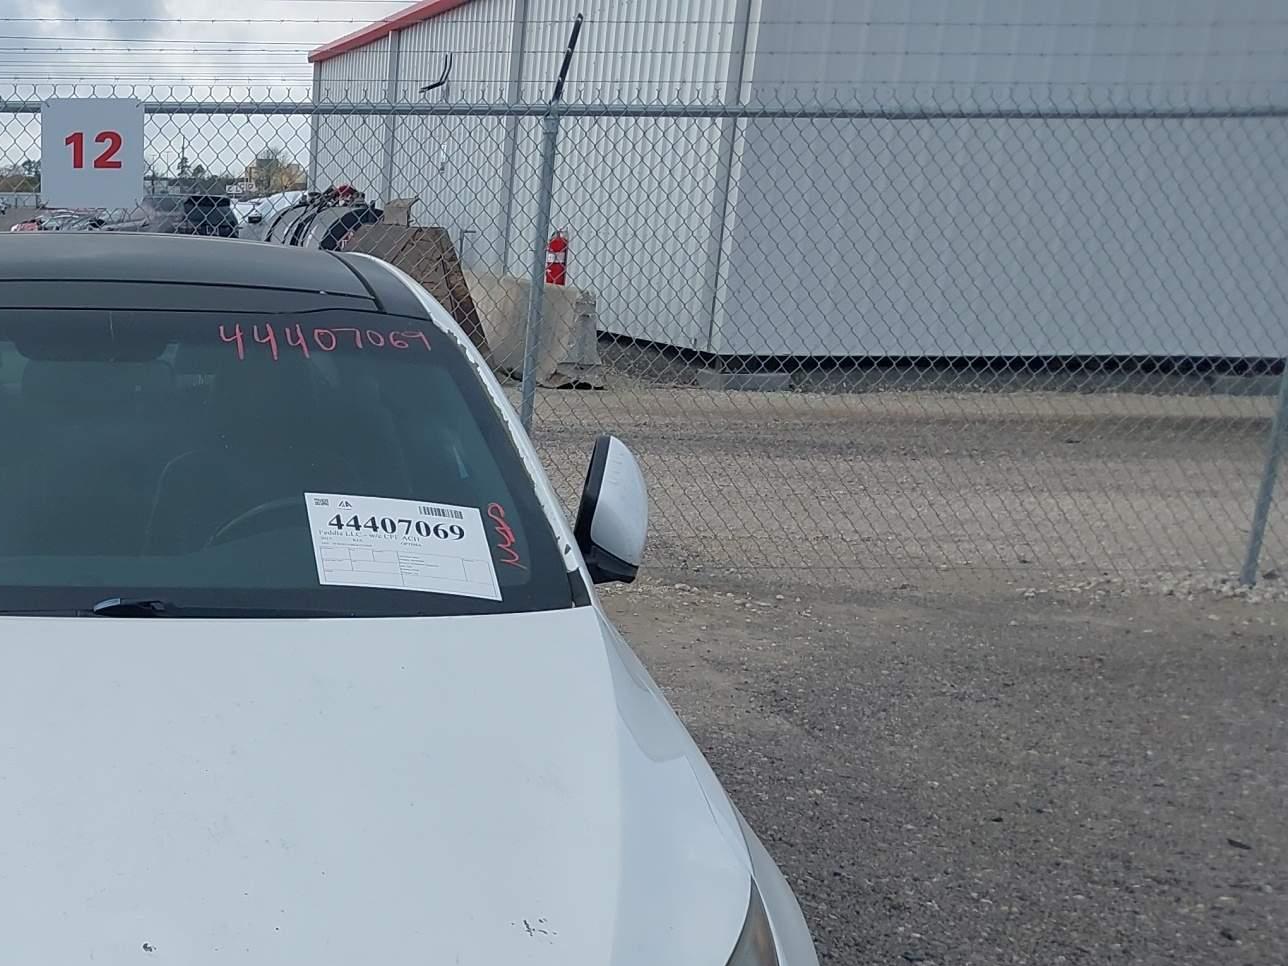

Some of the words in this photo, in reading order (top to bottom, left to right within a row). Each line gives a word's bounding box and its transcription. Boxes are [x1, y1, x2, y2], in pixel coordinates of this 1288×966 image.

[65, 131, 123, 169] 12
[218, 323, 432, 361] 44407069
[328, 514, 465, 541] 44407069
